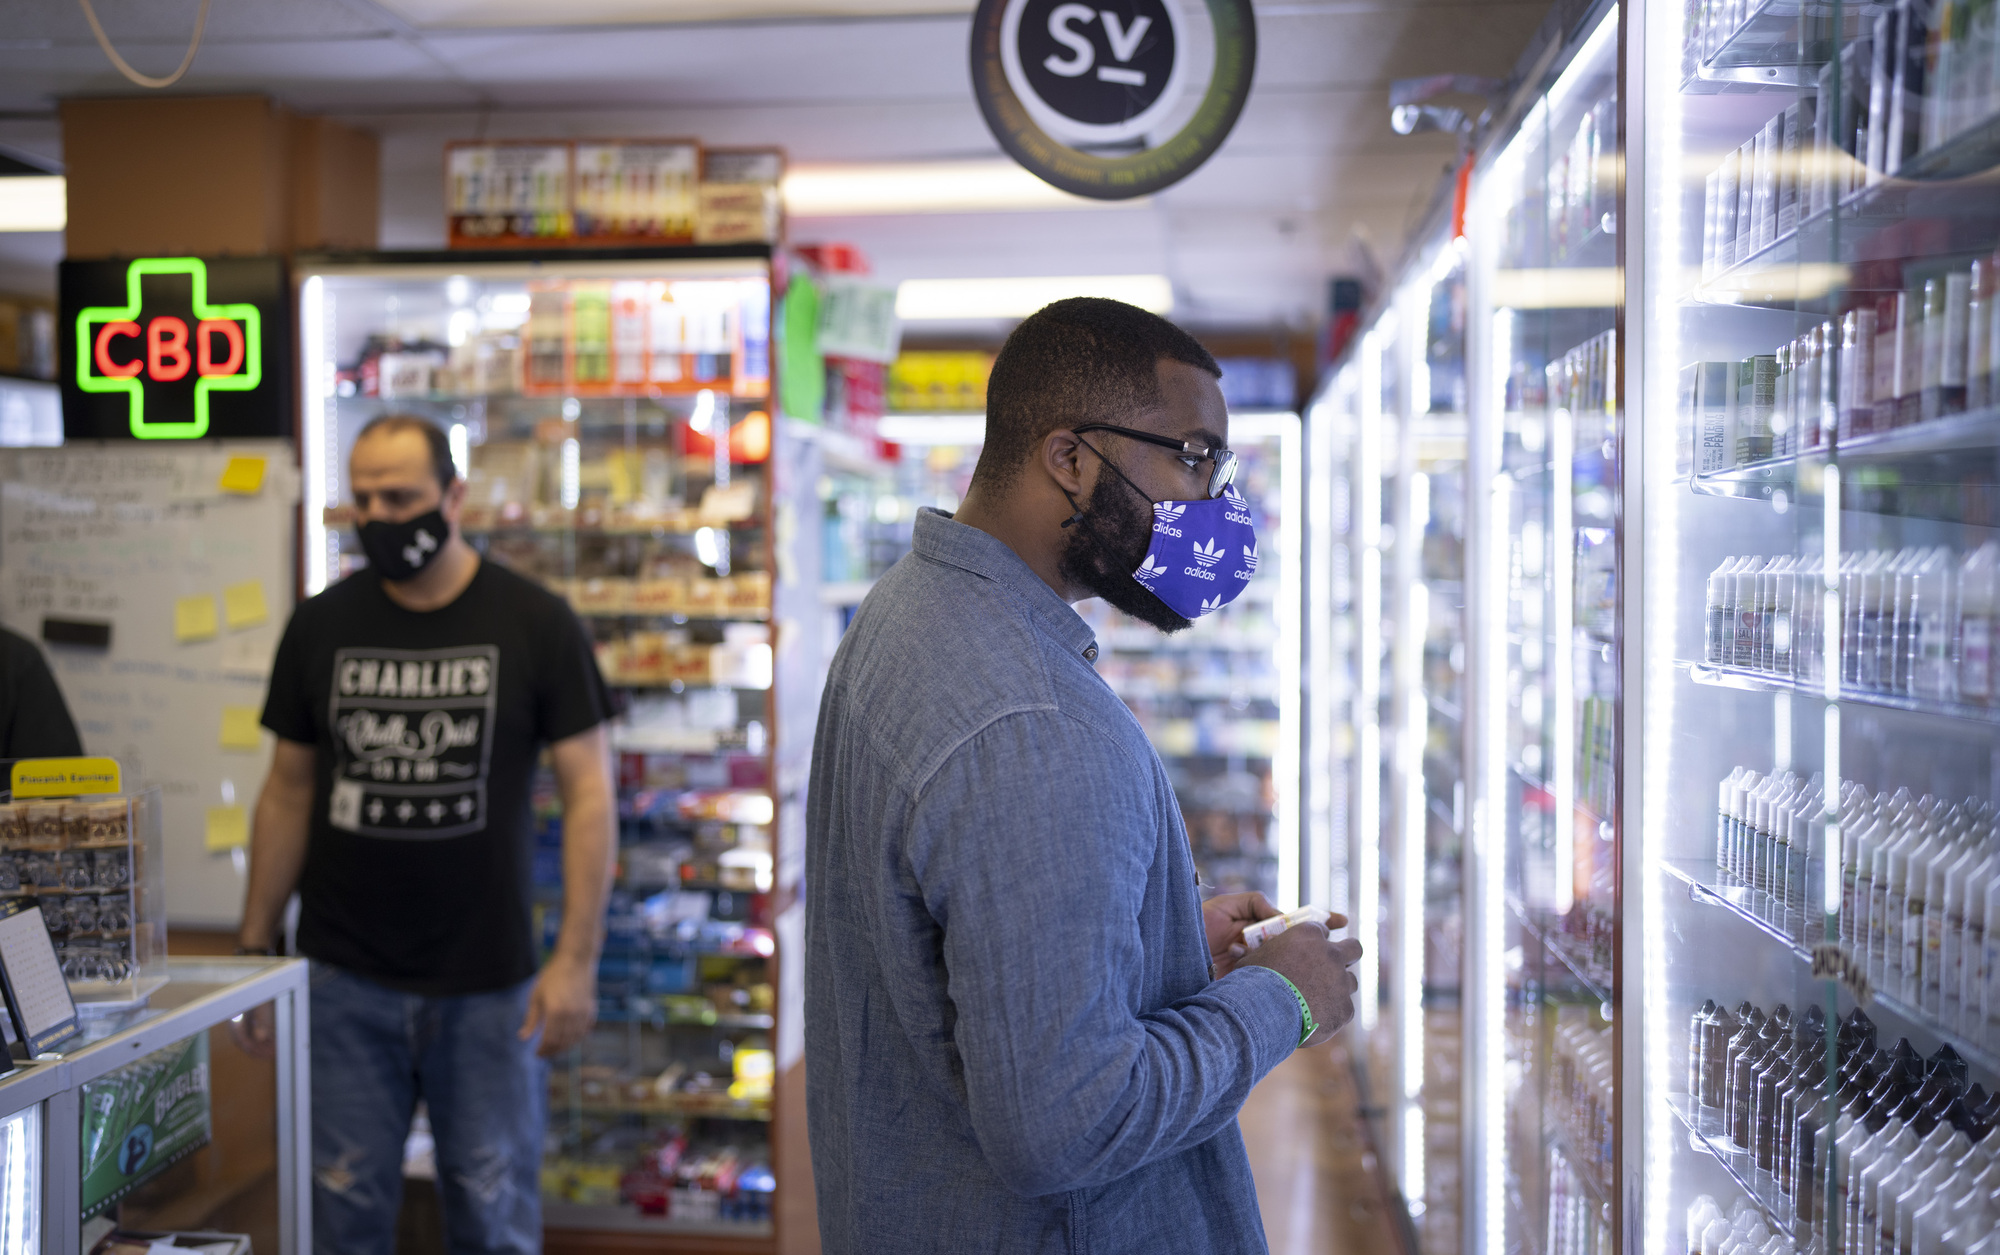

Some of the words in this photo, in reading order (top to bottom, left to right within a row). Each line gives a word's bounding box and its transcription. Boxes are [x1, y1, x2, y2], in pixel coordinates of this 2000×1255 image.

[94, 316, 245, 382] CBD
[1704, 413, 1714, 448] PATENT
[1714, 413, 1724, 448] PENDING
[1152, 521, 1183, 538] didas
[1184, 566, 1216, 581] adidas
[339, 657, 490, 697] CHARLIE'S
[70, 773, 114, 783] Earrings
